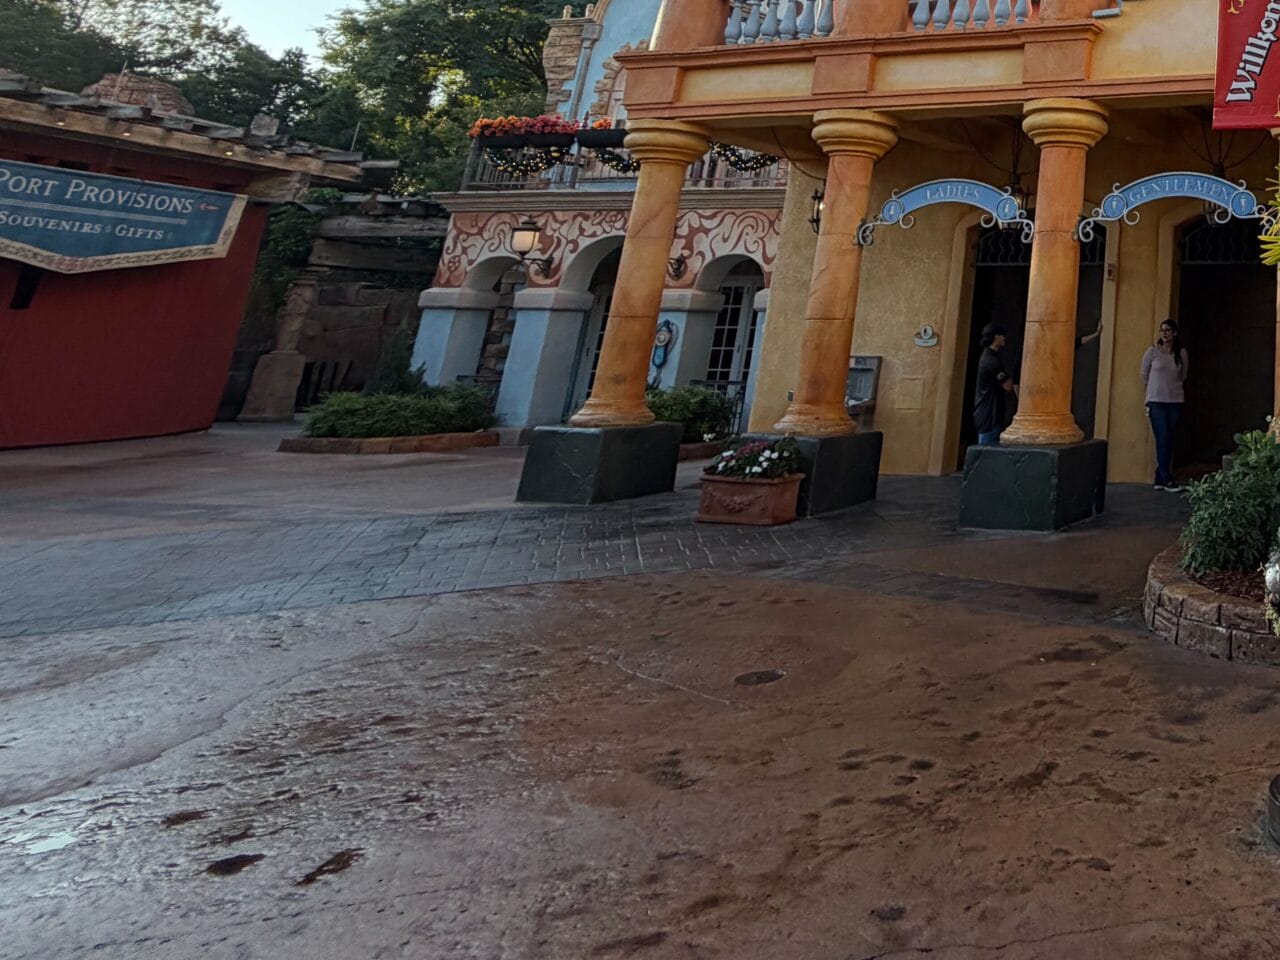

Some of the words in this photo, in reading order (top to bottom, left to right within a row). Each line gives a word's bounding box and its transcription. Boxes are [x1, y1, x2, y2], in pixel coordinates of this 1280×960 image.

[65, 179, 195, 214] PROVISIONS
[926, 184, 979, 200] LADIES
[1129, 178, 1228, 201] GENTLEMEN
[0, 210, 101, 234] SOUVENIRS
[115, 224, 165, 241] GIFTS
